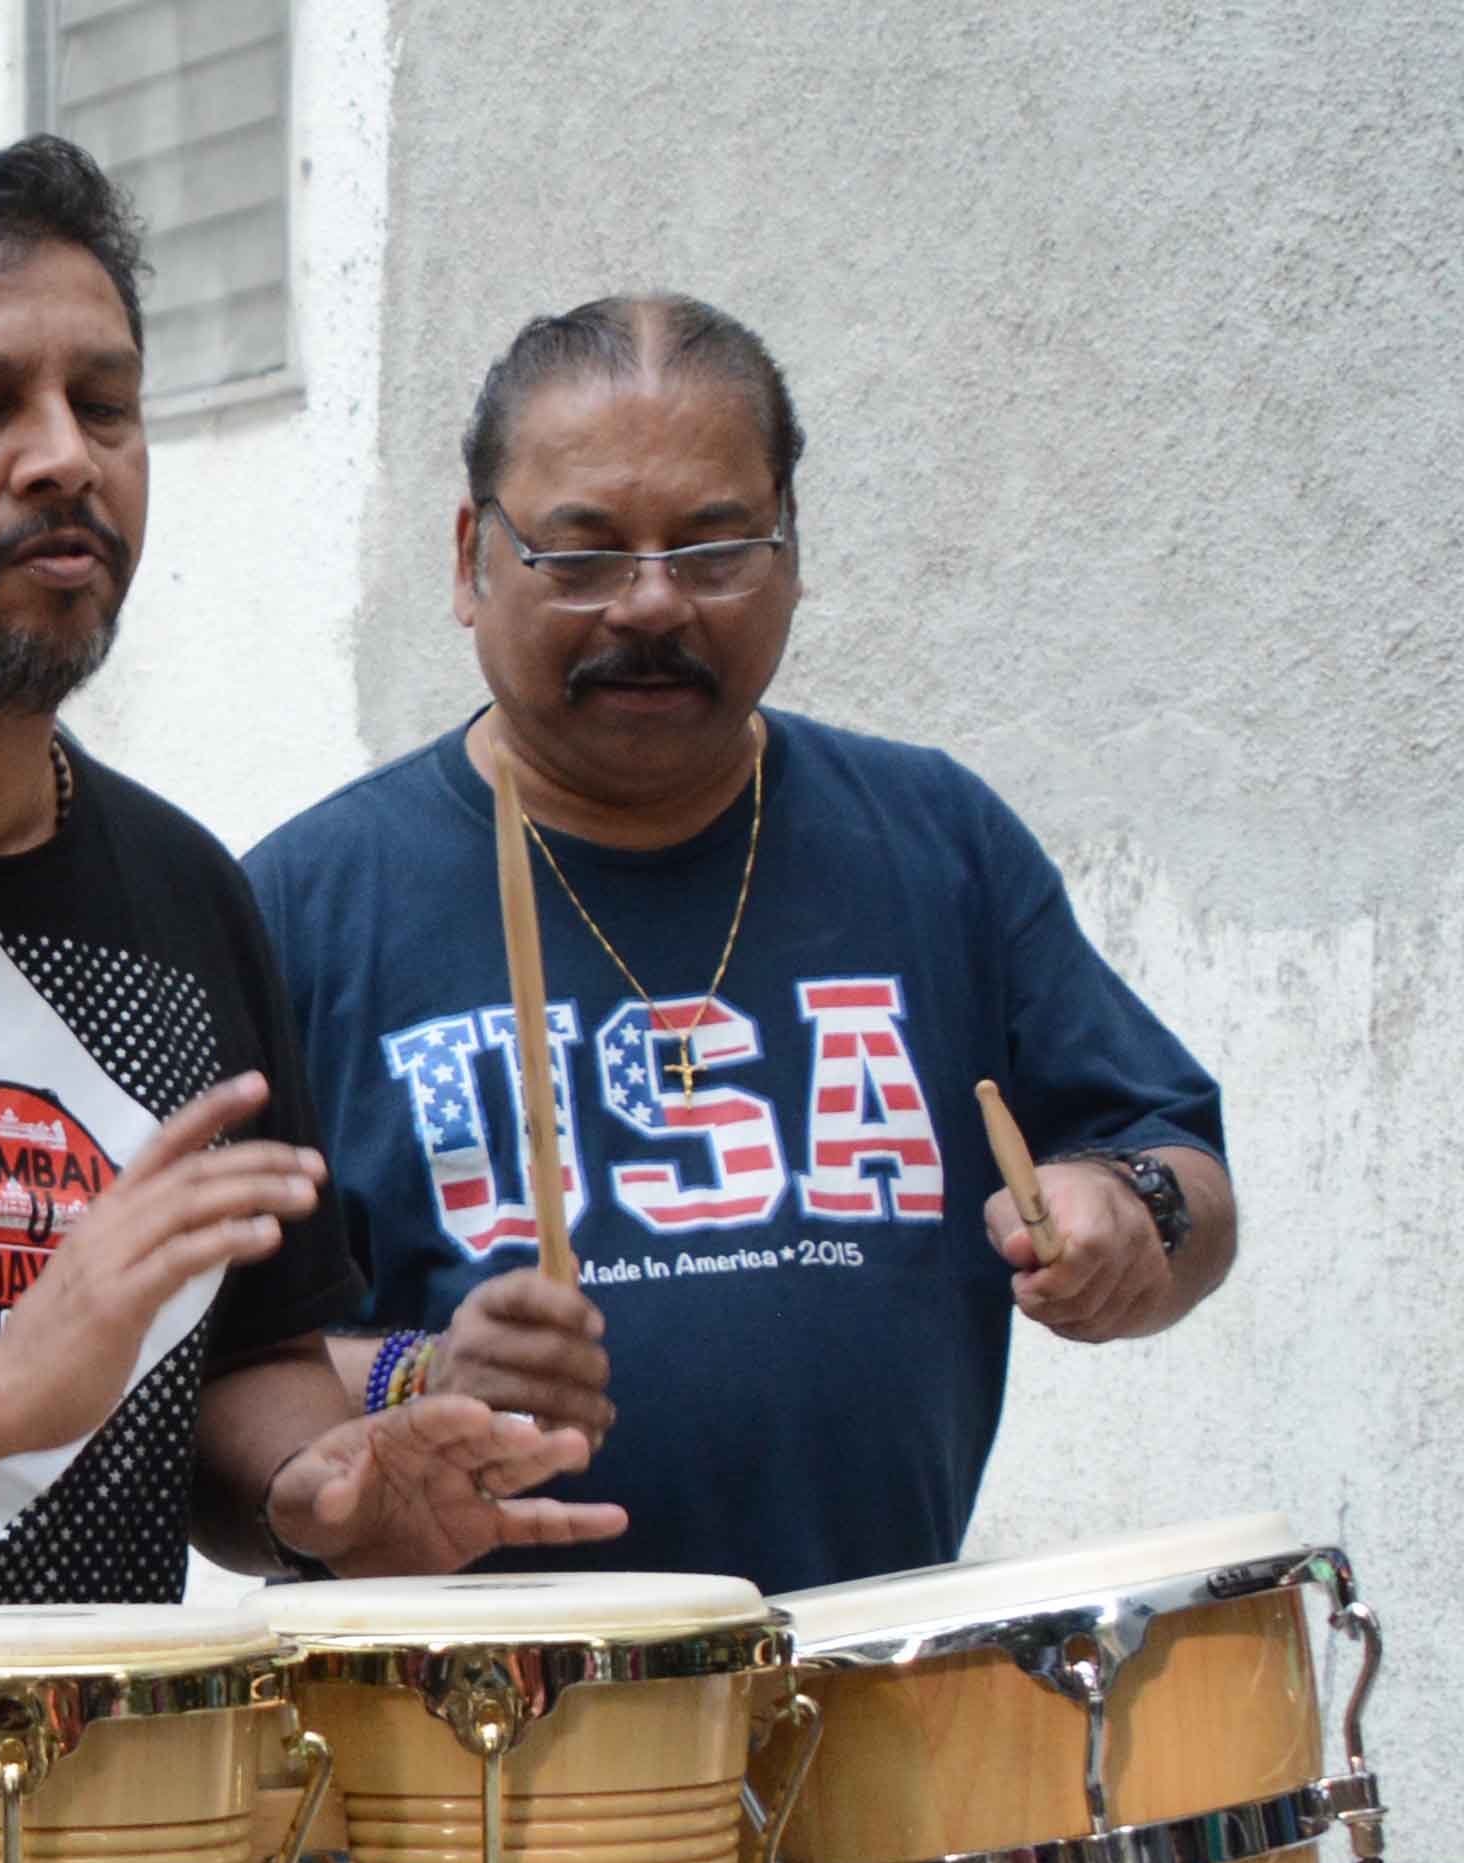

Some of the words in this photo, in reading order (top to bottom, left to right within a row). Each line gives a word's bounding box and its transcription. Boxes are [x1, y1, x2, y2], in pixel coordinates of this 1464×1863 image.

[382, 975, 945, 1263] USA
[675, 1248, 778, 1276] America
[798, 1239, 864, 1267] 2015
